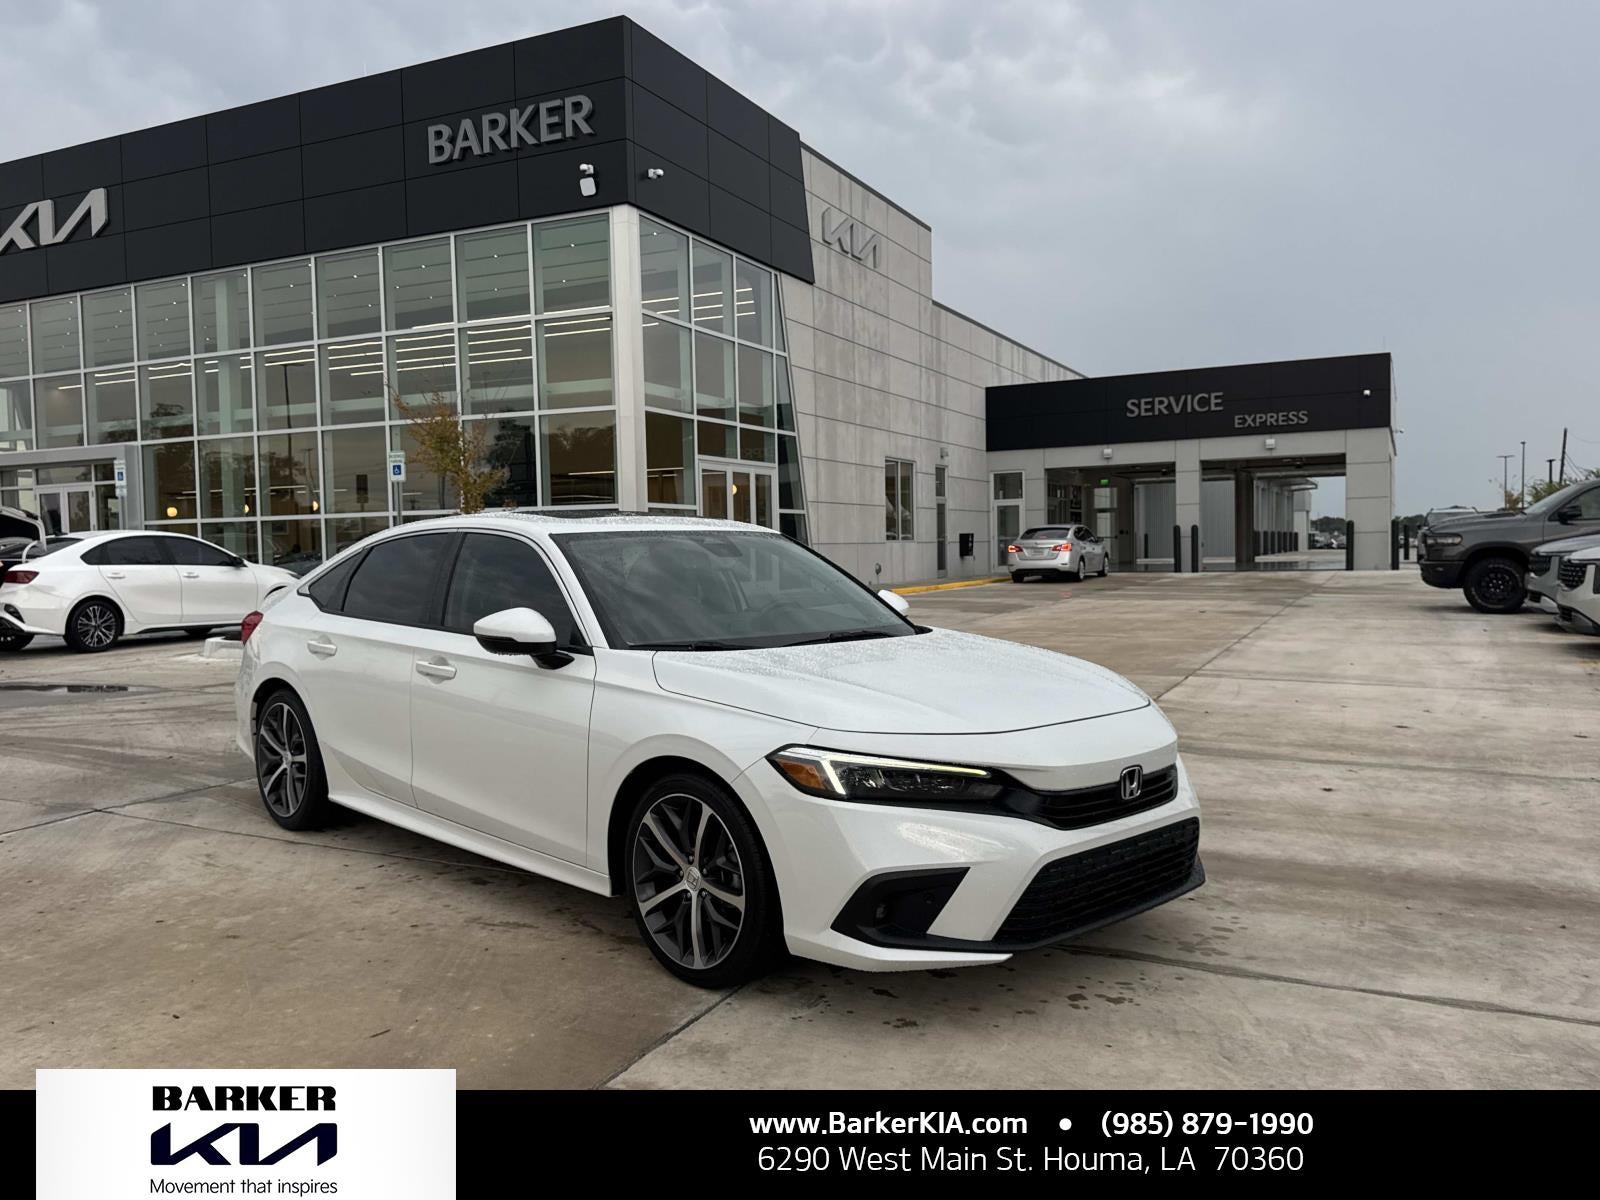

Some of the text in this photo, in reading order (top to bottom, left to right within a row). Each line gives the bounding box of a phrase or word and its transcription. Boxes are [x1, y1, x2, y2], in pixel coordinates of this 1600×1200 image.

[427, 94, 594, 164] BARKER
[821, 206, 881, 269] KIA
[1126, 391, 1224, 417] SERVICE
[1234, 410, 1309, 428] EXPRESS
